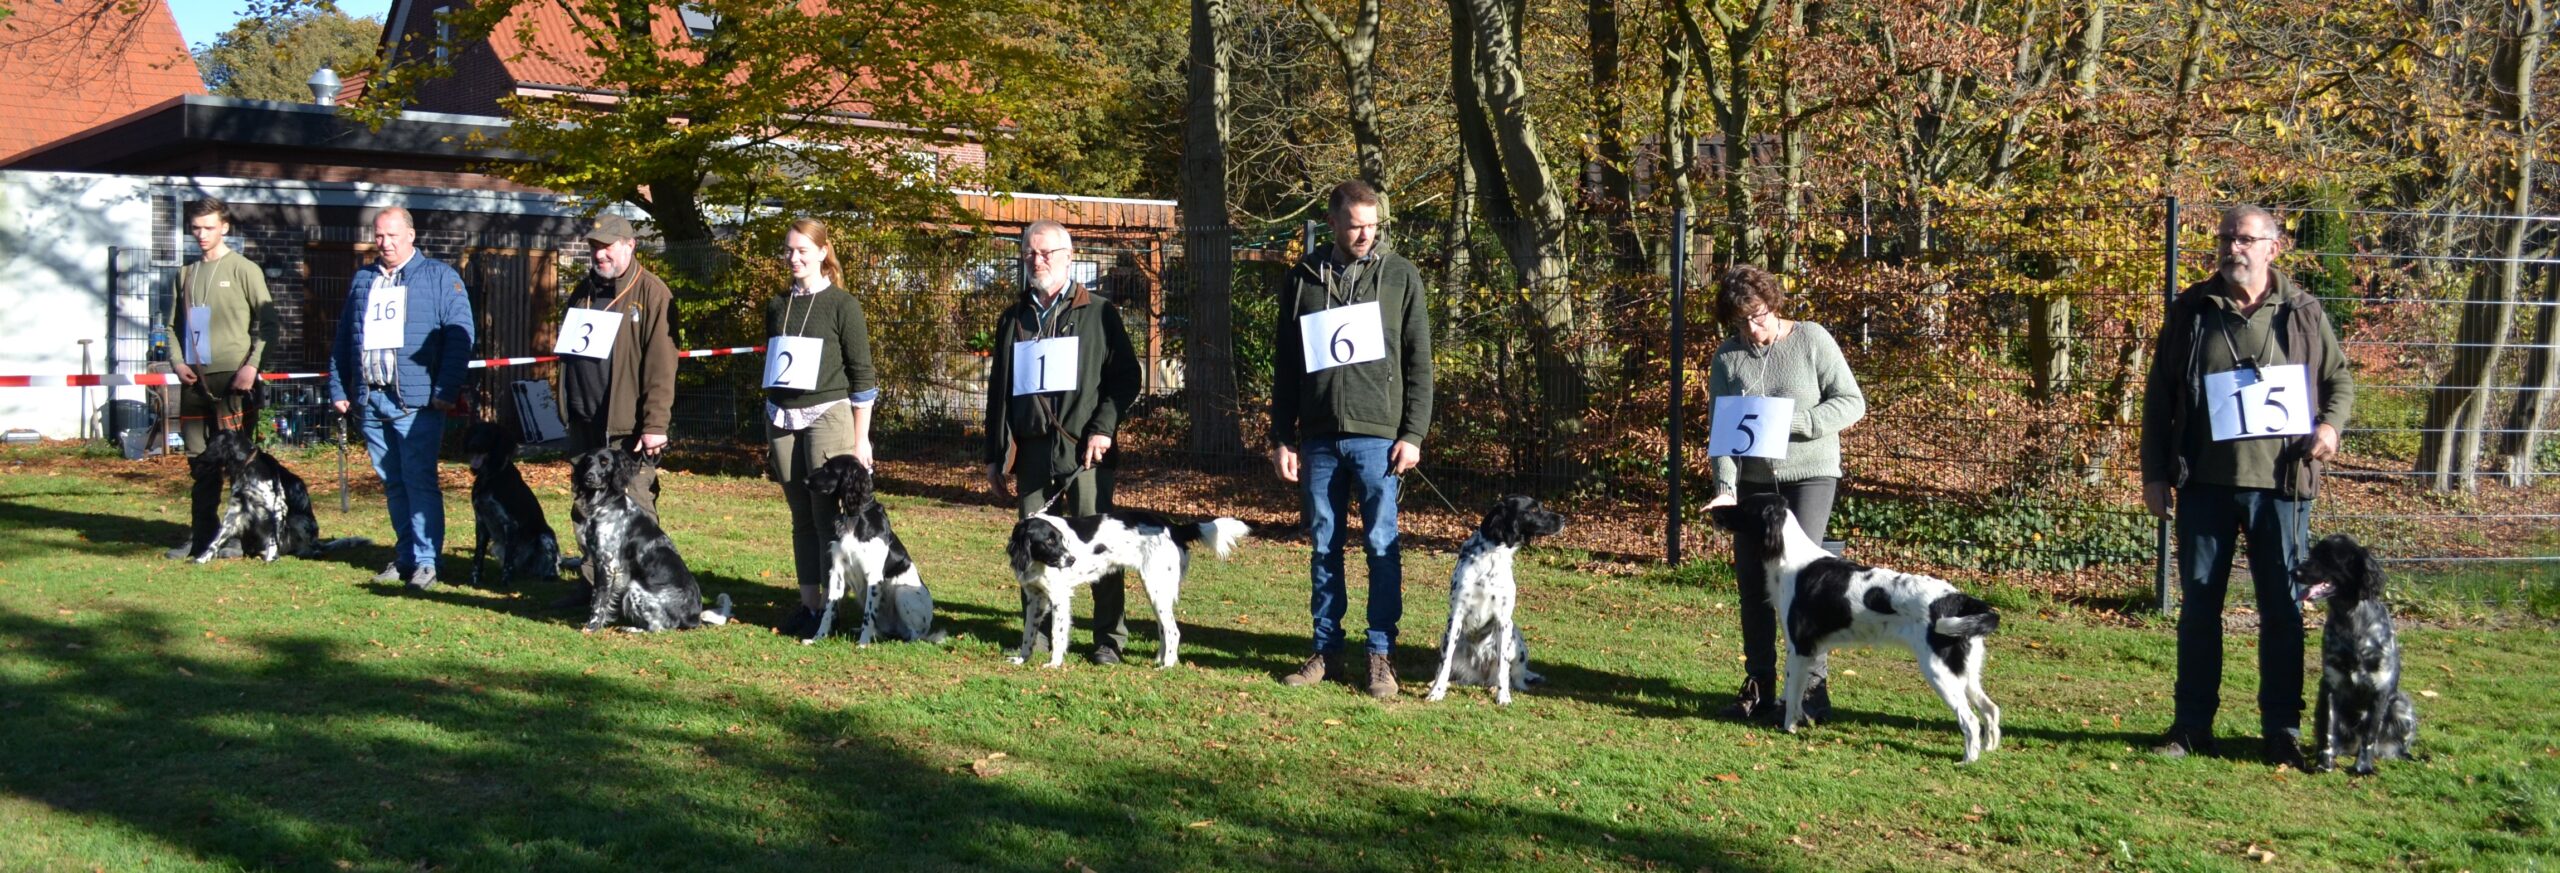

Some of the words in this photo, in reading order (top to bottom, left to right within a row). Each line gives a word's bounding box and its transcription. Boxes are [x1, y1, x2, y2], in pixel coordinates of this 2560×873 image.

[373, 300, 396, 321] 16
[571, 323, 593, 353] 3
[1330, 323, 1355, 364] 6
[773, 351, 793, 386] 2
[1036, 355, 1048, 391] 1
[2229, 387, 2290, 436] 15
[1731, 414, 1759, 455] 5
